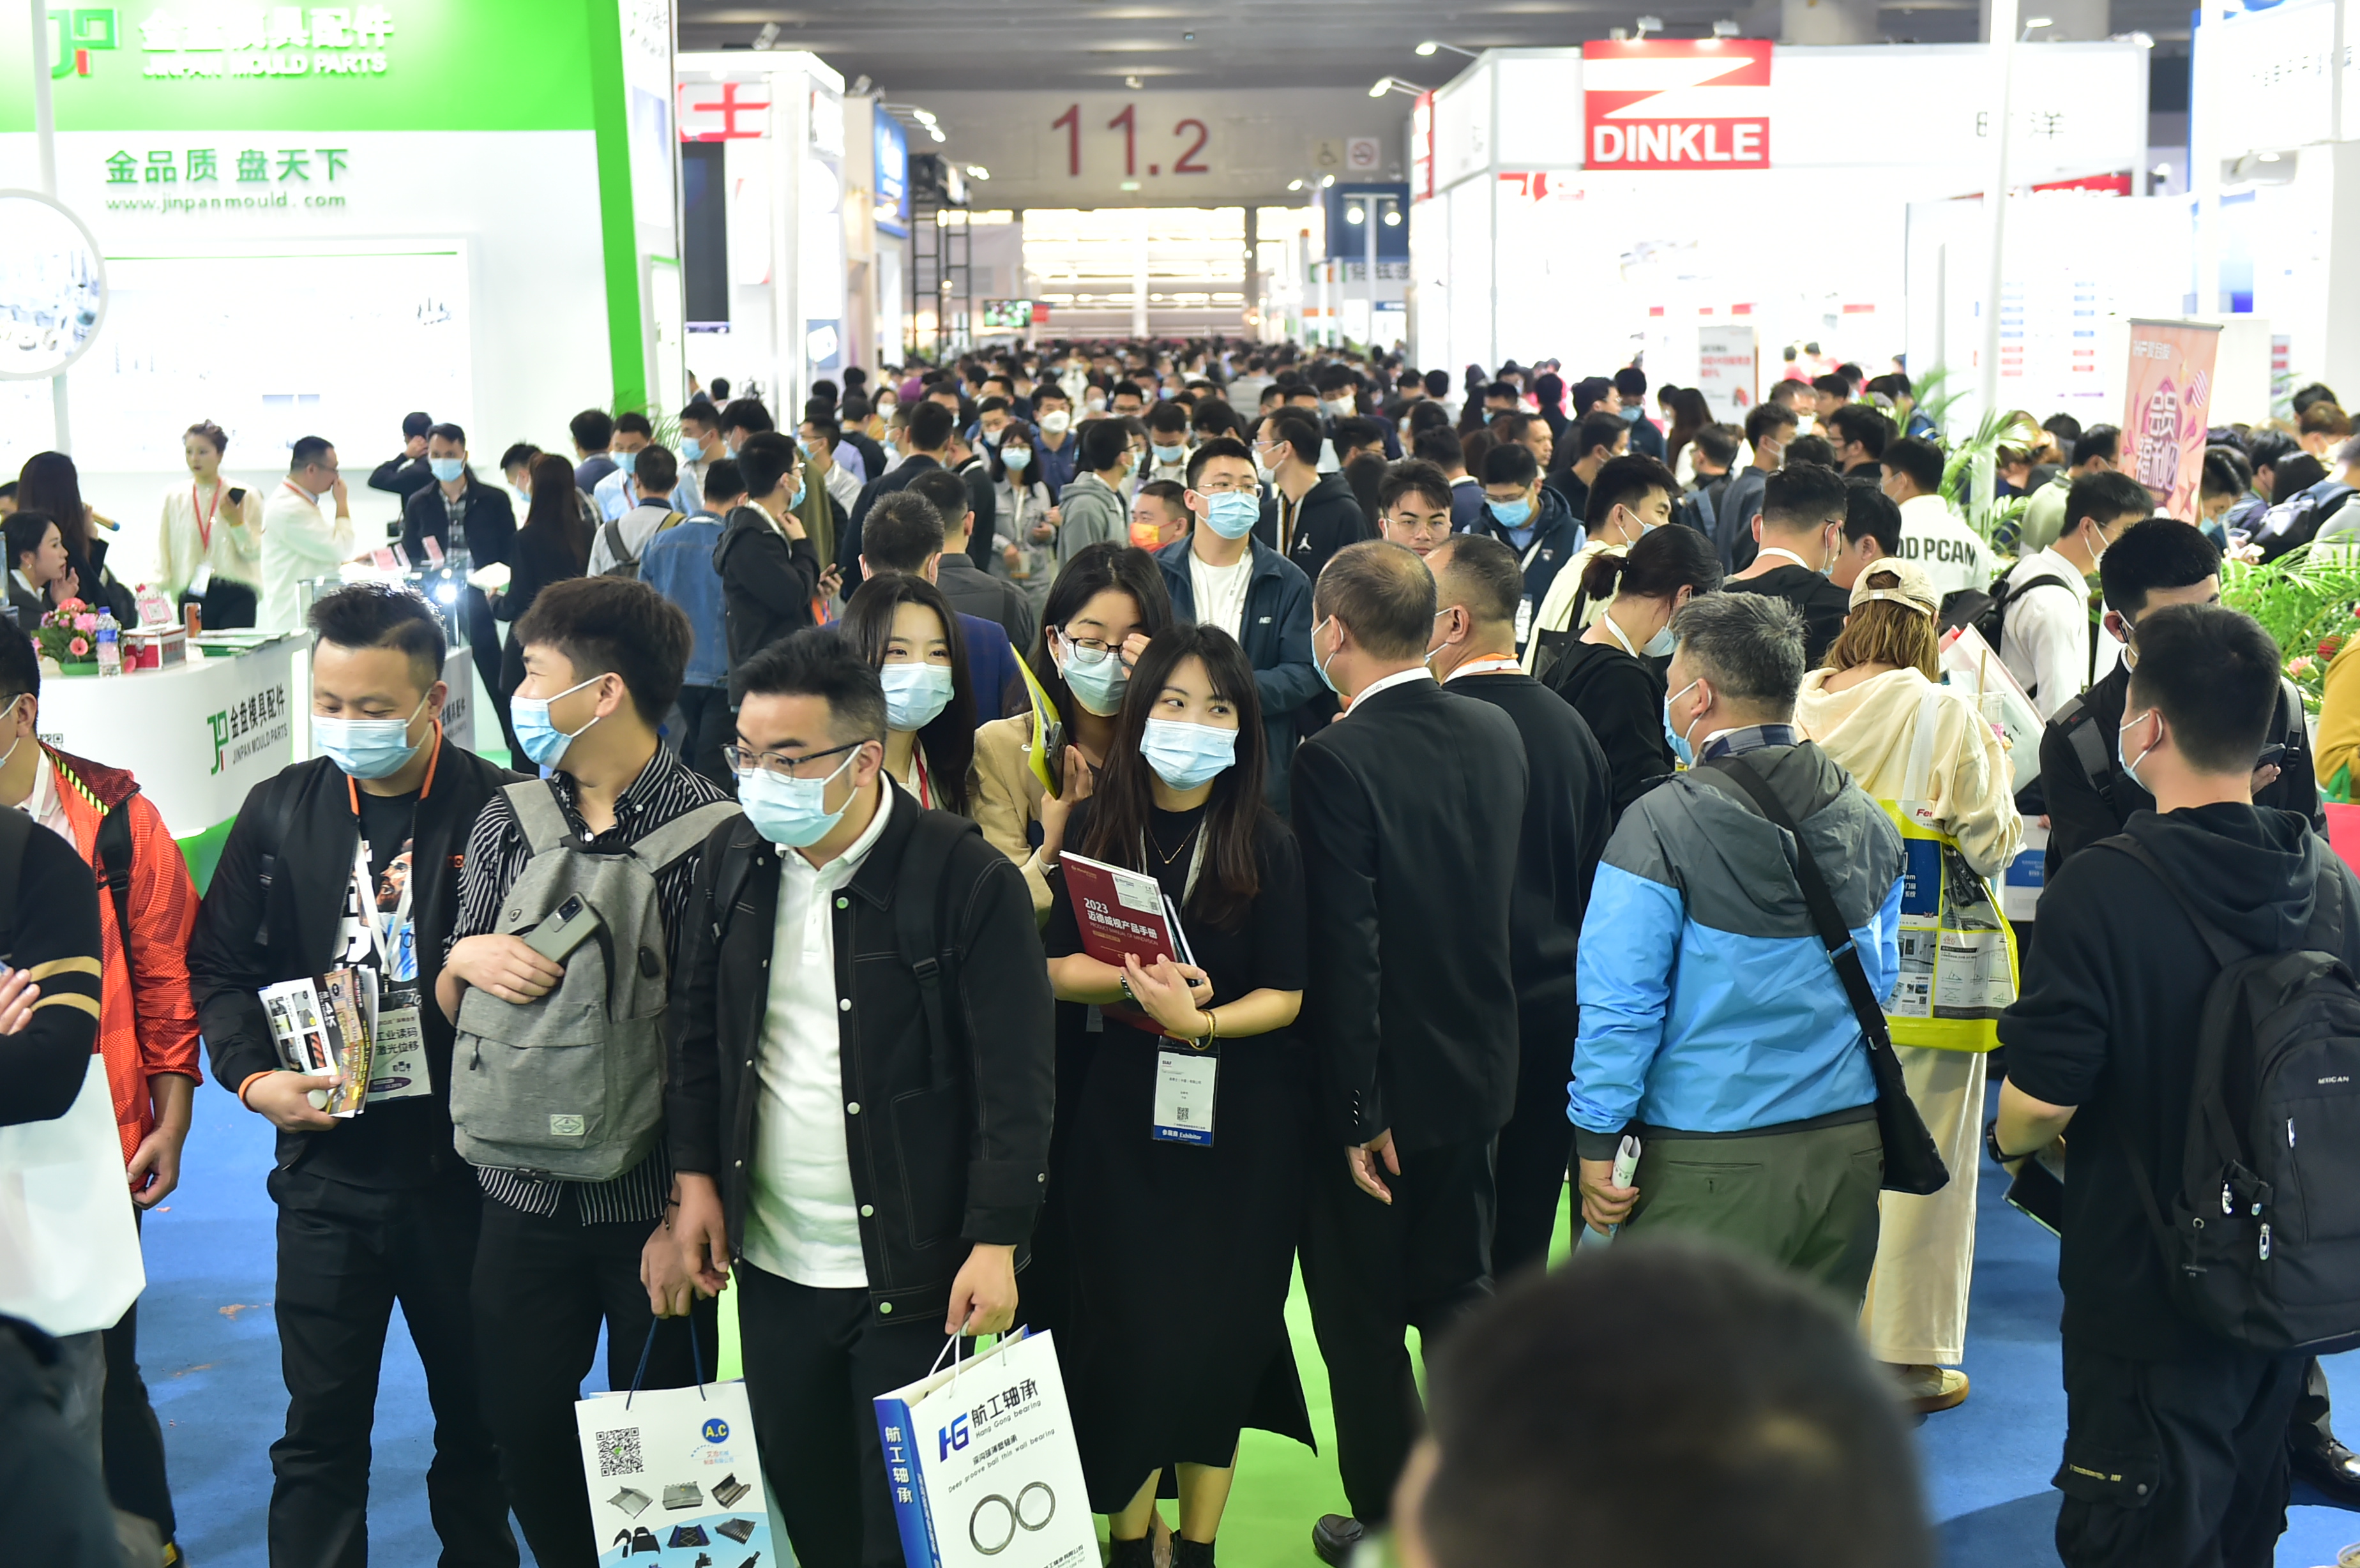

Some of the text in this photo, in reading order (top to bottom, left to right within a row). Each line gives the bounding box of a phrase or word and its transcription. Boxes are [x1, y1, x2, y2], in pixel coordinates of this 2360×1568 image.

[314, 52, 387, 74] PARTS
[1051, 103, 1210, 177] 11.2
[1593, 123, 1762, 163] DINKLE
[105, 149, 349, 183] 金品质 盘天下
[231, 681, 285, 739] 金盘模具配件
[251, 730, 271, 754] MOULD
[270, 722, 288, 743] PARTS
[1084, 897, 1109, 914] 2023
[400, 931, 414, 949] 10
[1087, 910, 1158, 940] 迈德威视产品手册
[1089, 921, 1109, 932] PRODUCT
[1108, 926, 1126, 937] MANUAL
[375, 1027, 418, 1042] 工业读码
[375, 1040, 420, 1055] 激光位移
[971, 1377, 1039, 1429] 航工轴承
[975, 1399, 1042, 1439] Hang Gong bearing
[706, 1424, 727, 1438] A.C
[938, 1412, 969, 1463] HG
[885, 1426, 914, 1504] 航工轴承
[948, 1428, 1055, 1494] Deep groove ball thin wall bearing
